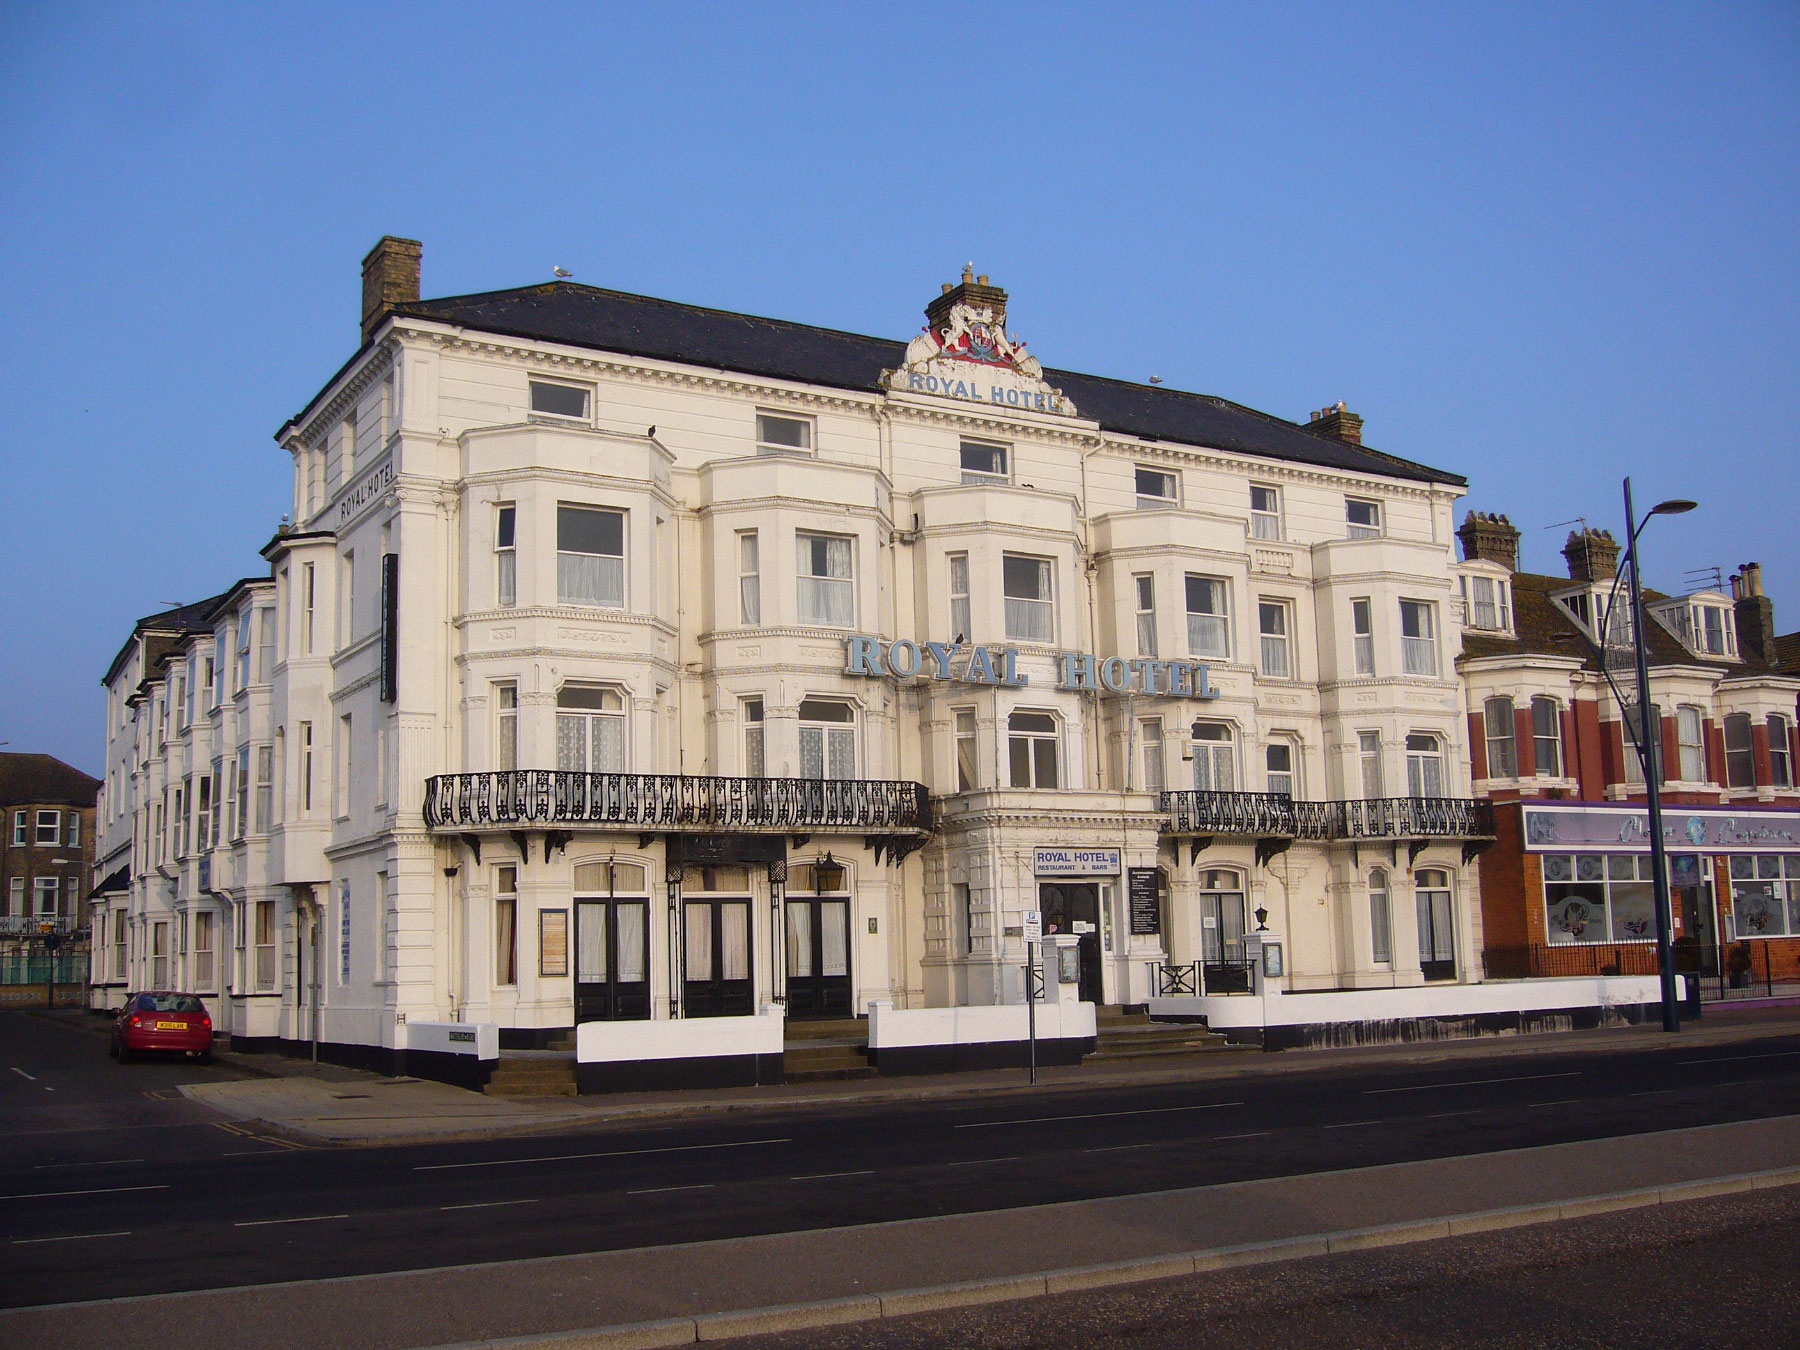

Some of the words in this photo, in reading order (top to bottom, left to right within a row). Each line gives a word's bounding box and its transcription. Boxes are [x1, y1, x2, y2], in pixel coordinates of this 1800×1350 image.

[909, 373, 982, 400] ROYAL
[341, 486, 365, 521] ROYAL
[844, 635, 1029, 688] ROYAL
[1059, 652, 1221, 700] HOTEL
[1037, 852, 1071, 862] ROYAL
[1074, 852, 1109, 862] HOTEL
